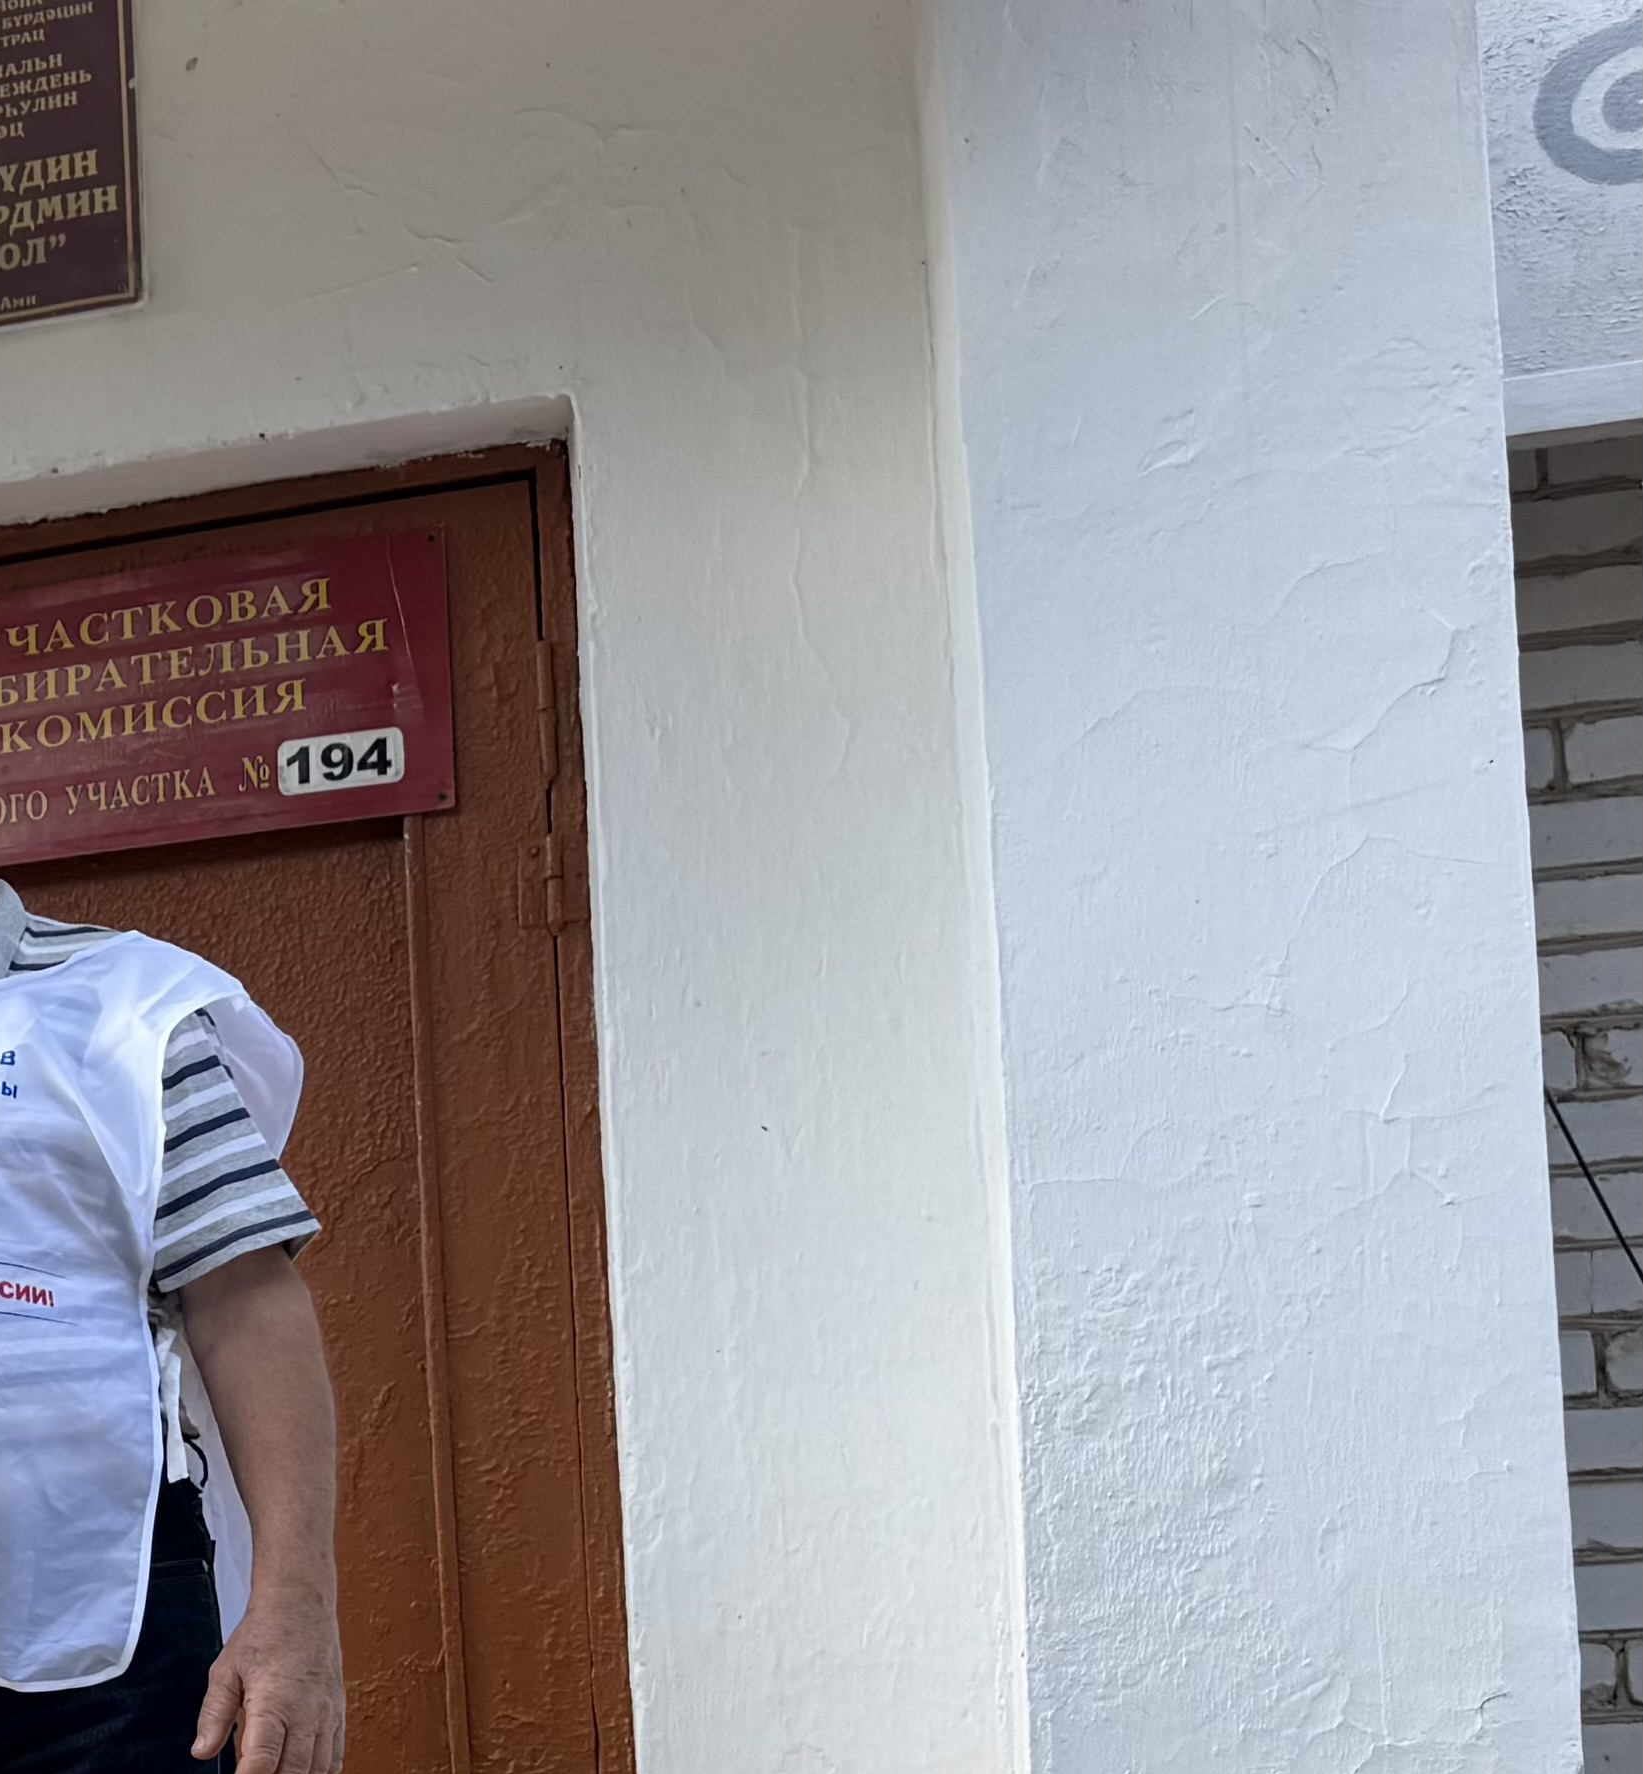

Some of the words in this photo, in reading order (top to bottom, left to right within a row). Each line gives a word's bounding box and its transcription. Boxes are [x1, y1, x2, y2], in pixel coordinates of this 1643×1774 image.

[0, 678, 307, 755] КОМИССИЯ
[64, 766, 216, 817] УЧАСТКА
[238, 756, 271, 792] №
[286, 736, 393, 786] 194
